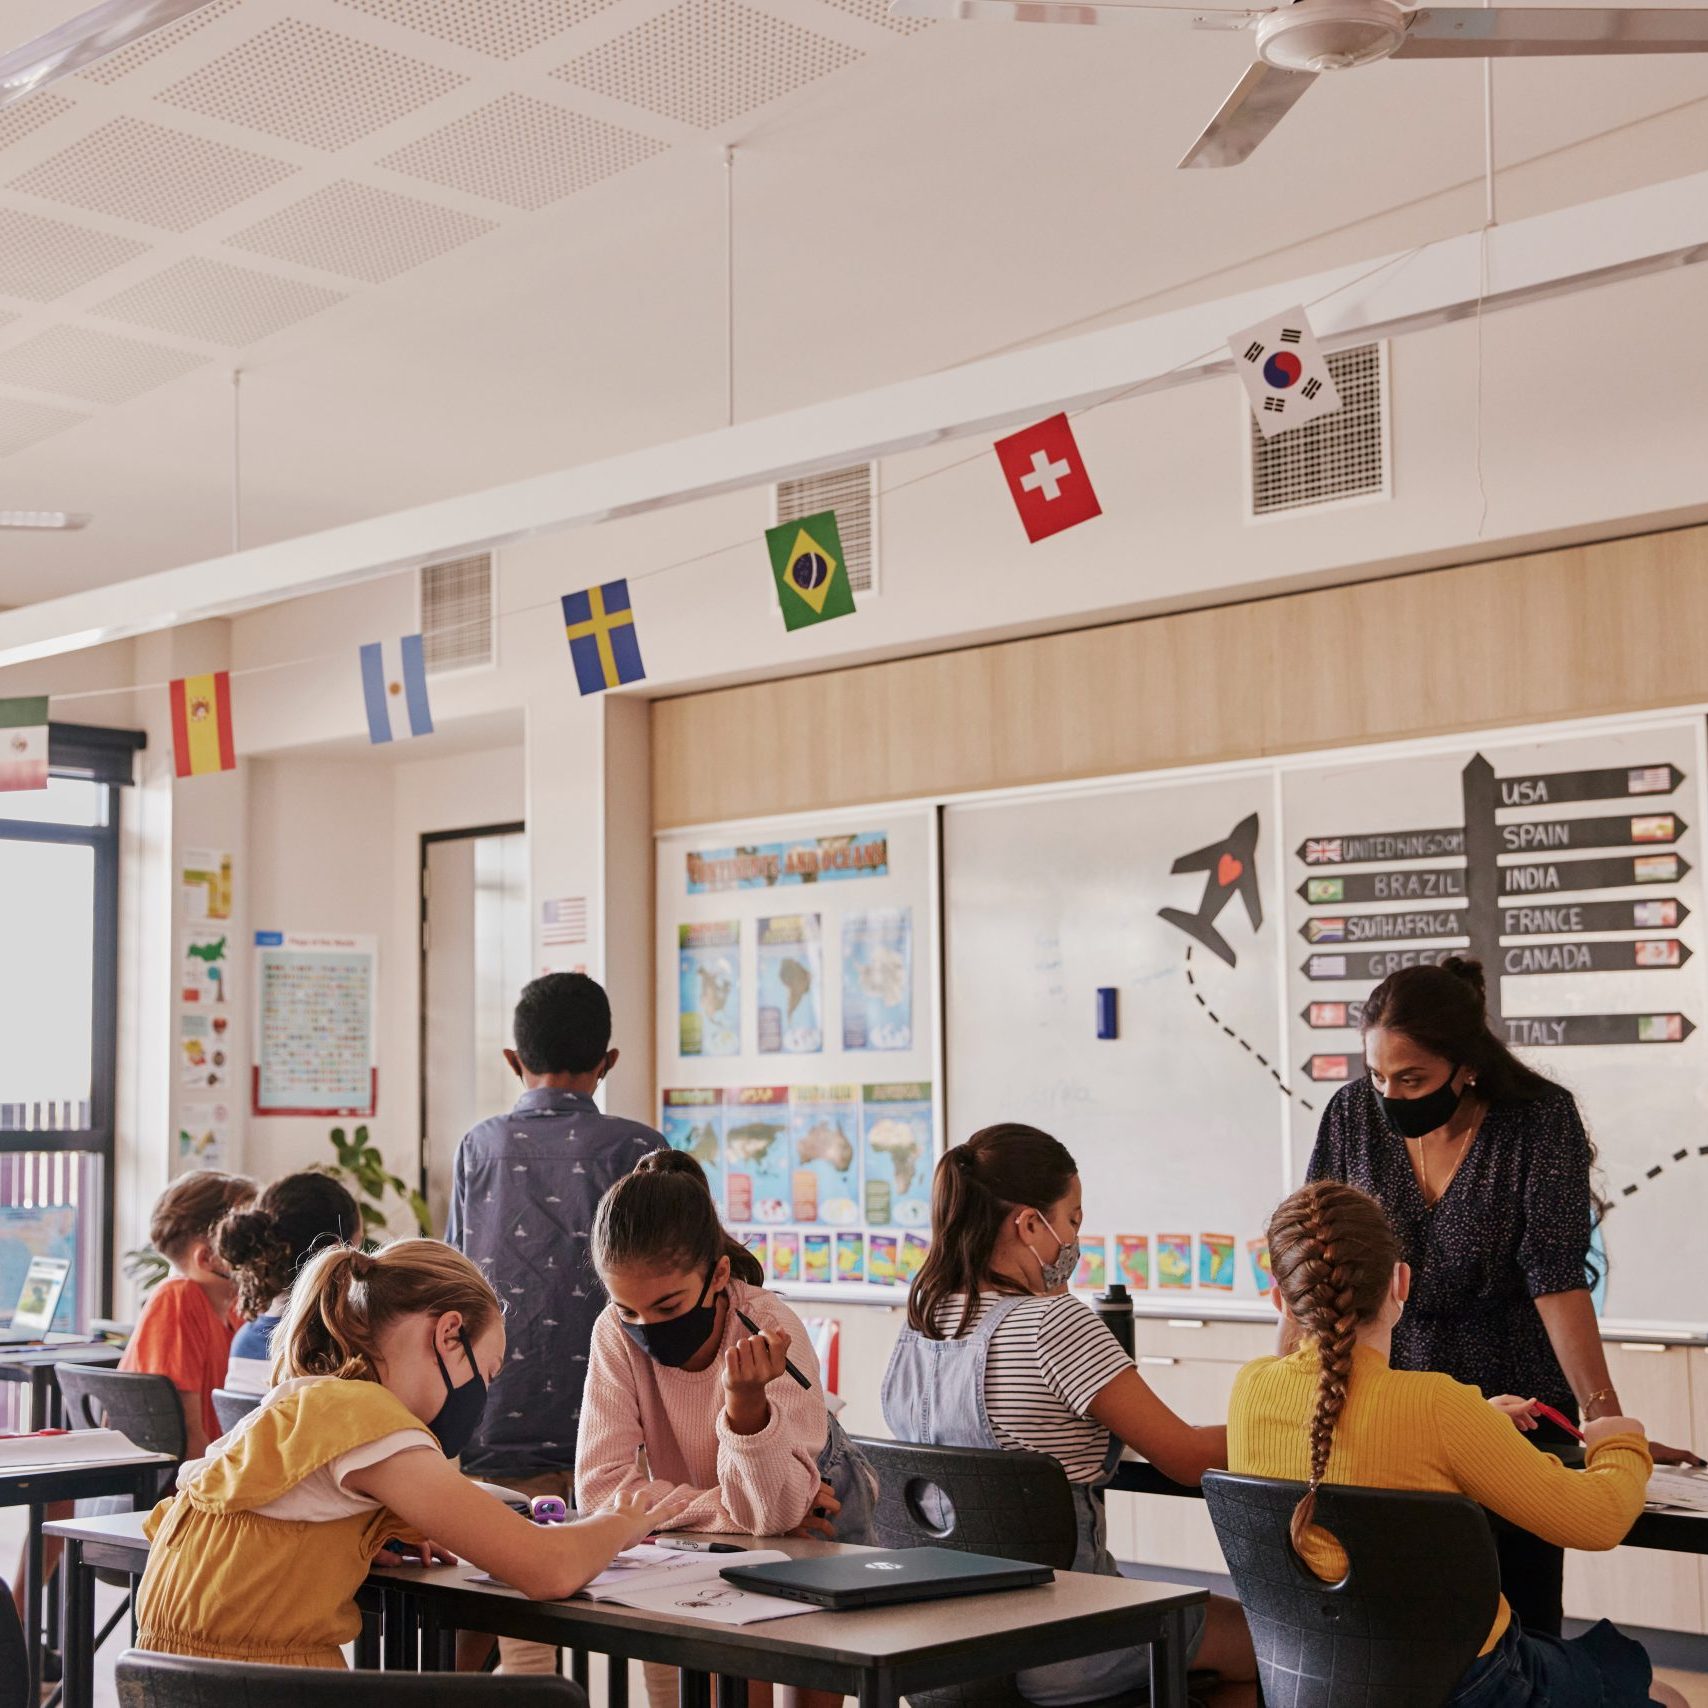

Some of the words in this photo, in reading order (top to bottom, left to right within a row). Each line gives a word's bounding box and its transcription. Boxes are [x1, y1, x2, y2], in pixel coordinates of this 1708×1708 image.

[1501, 780, 1549, 805] USA
[1503, 823, 1570, 850] SPAIN
[1374, 873, 1460, 898] BRAZIL
[1505, 865, 1560, 892] INDIA
[1504, 906, 1584, 934] FRANCE
[1504, 943, 1592, 974] CANADA
[1505, 1018, 1567, 1047] ITALY
